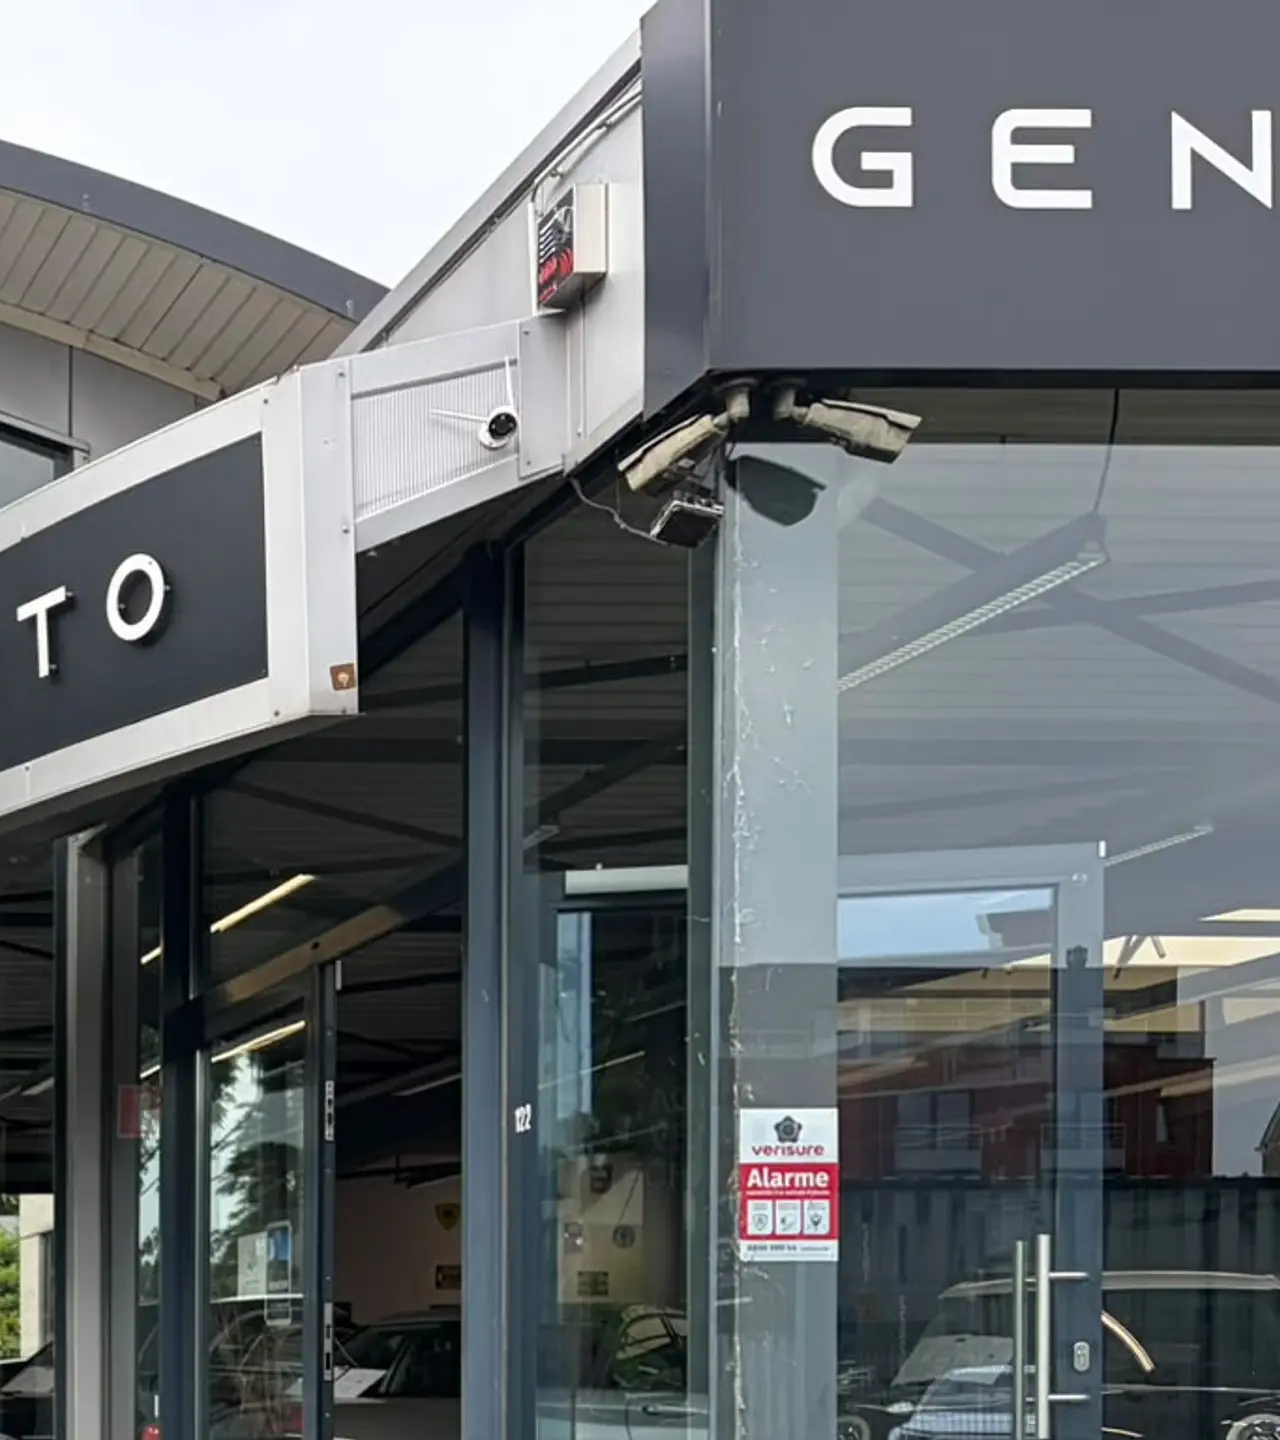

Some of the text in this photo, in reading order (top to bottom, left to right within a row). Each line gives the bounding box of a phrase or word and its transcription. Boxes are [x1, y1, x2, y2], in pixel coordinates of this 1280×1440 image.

[811, 105, 1273, 210] GEN
[751, 1143, 826, 1157] verisure
[747, 1165, 830, 1189] Alarme
